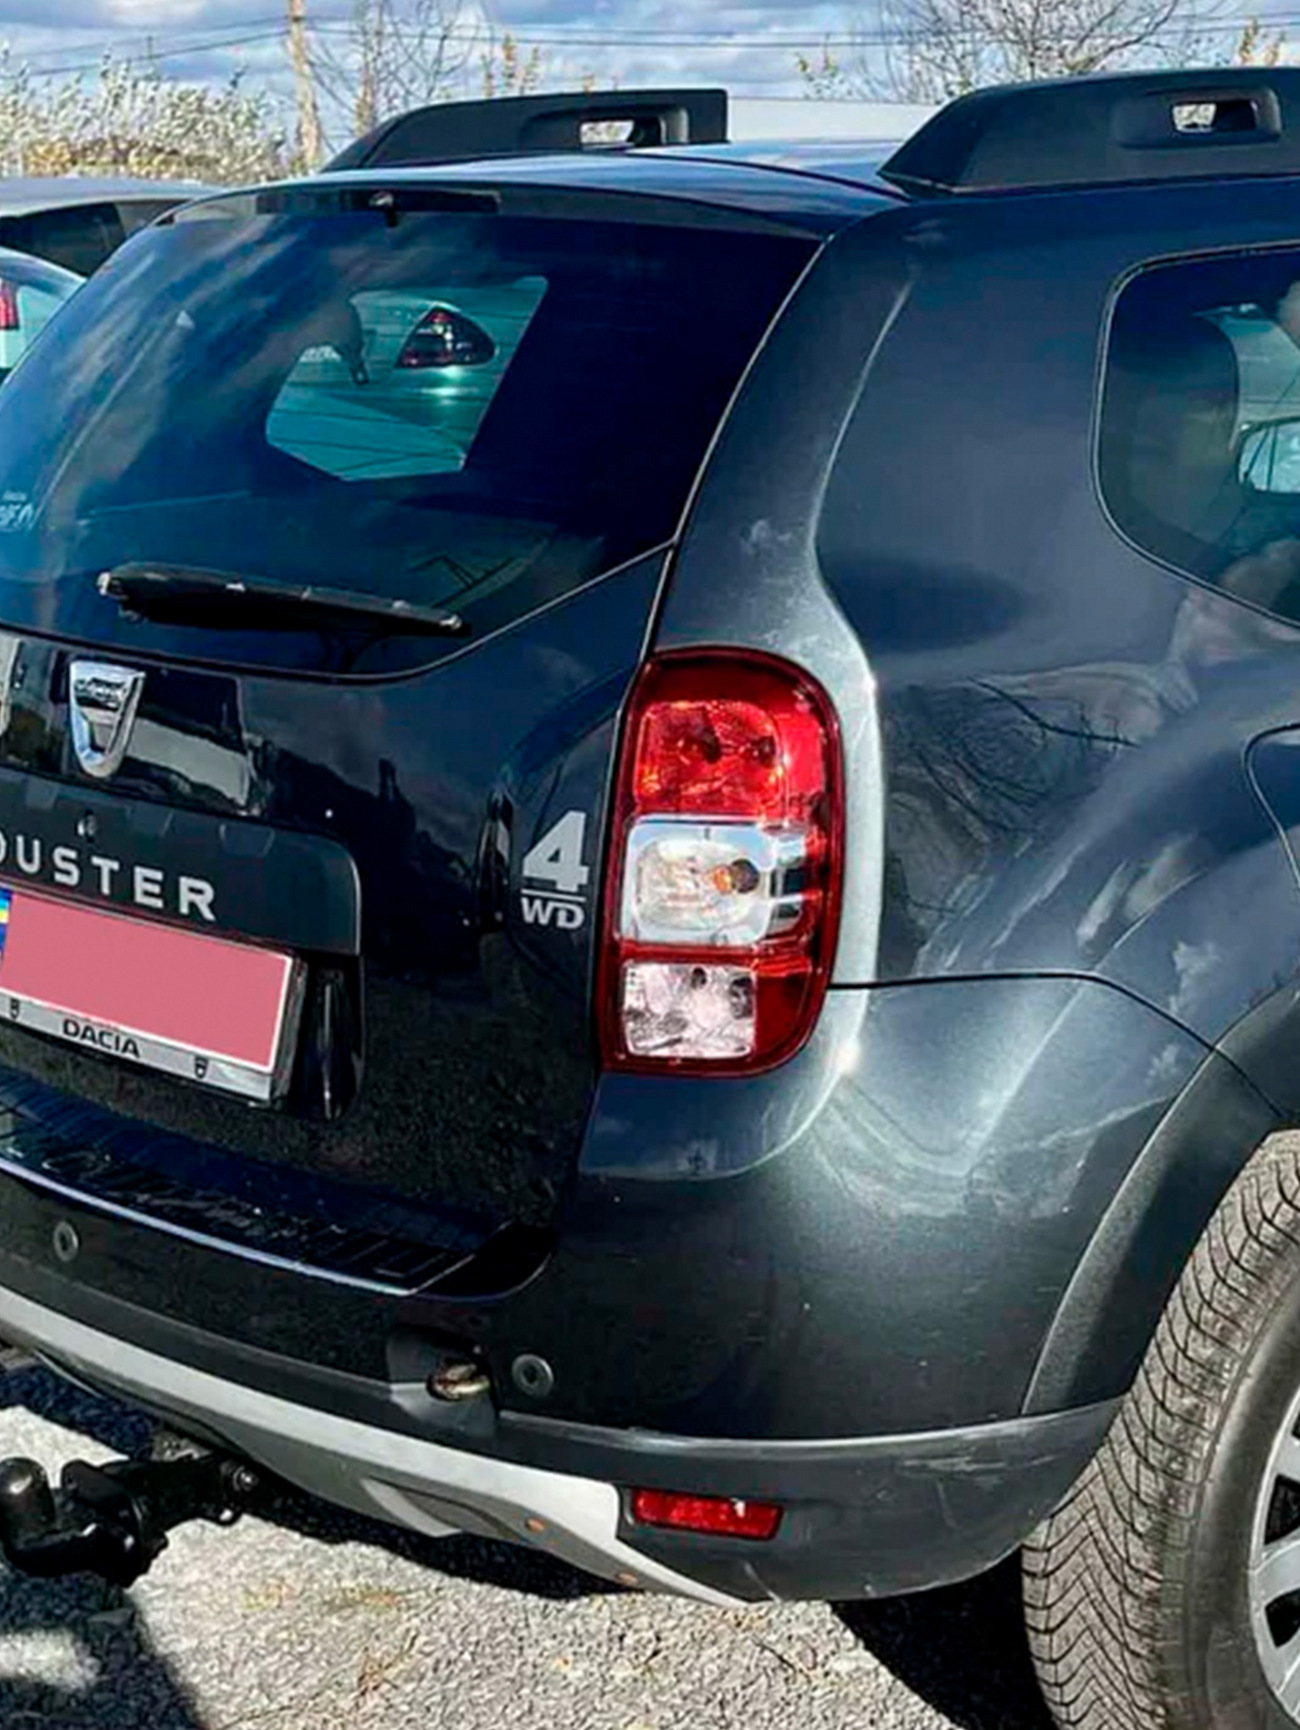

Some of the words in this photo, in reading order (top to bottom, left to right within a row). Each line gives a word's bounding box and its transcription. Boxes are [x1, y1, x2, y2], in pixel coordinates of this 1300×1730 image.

[0, 831, 216, 921] USTER
[523, 810, 590, 892] 4
[521, 897, 585, 929] WD
[62, 1017, 141, 1058] DACIA
